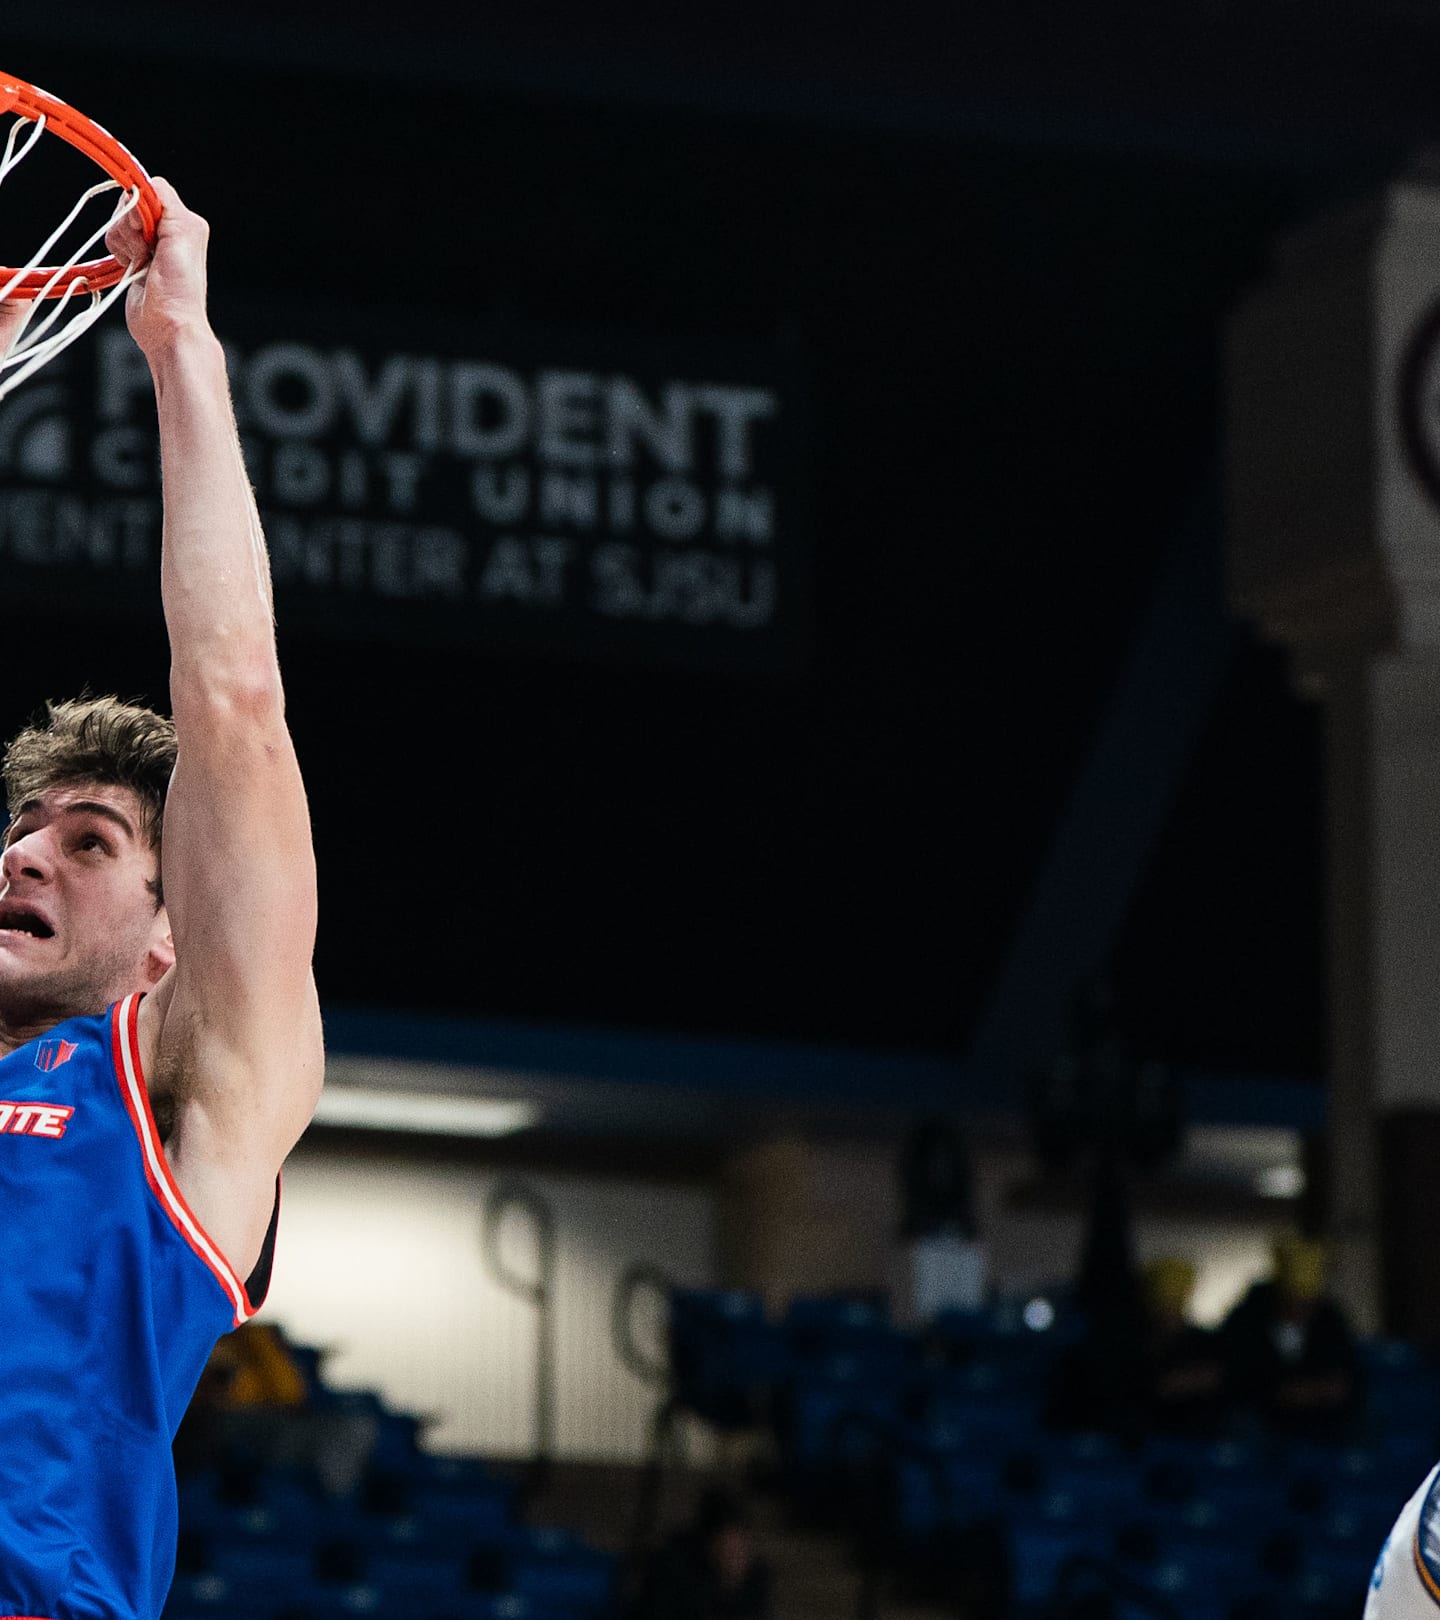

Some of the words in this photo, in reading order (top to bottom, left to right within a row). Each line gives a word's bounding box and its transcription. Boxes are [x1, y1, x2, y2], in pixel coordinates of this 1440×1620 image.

[95, 327, 777, 475] POVIDENT
[90, 430, 422, 513] CDIT
[468, 462, 776, 545] UNION
[268, 510, 466, 597] NTER
[478, 534, 574, 606] AT
[588, 541, 778, 630] SJSU
